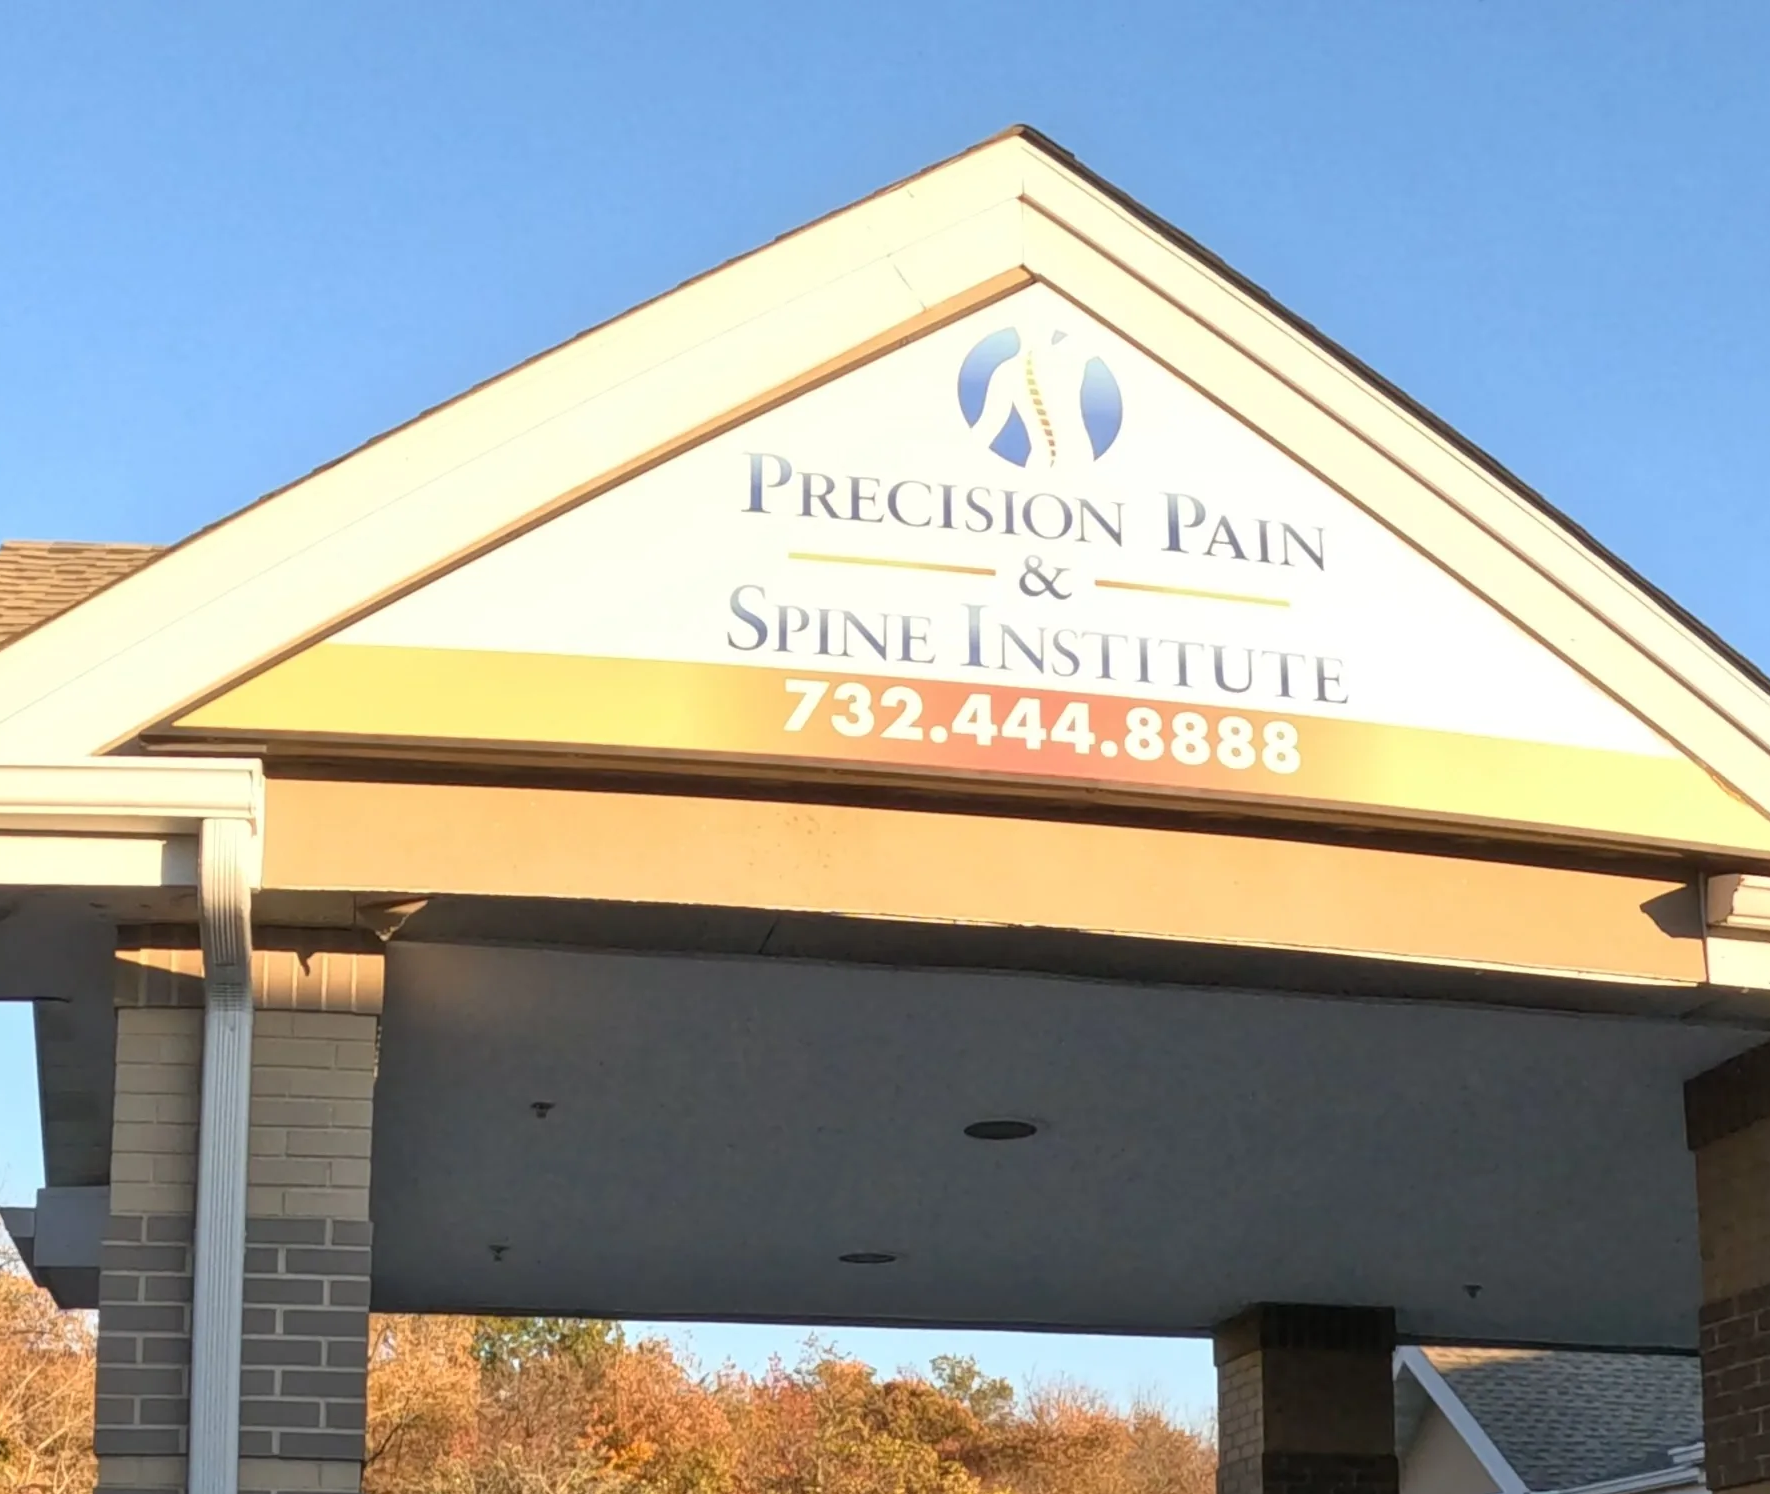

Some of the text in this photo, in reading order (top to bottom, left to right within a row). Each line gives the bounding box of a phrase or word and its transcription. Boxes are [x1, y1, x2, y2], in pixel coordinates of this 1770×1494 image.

[741, 451, 1326, 572] PRECISION PAIN
[1019, 553, 1073, 600] &
[726, 583, 1350, 705] SPINE INSTITUTE
[783, 679, 1302, 775] 732.444.8888
